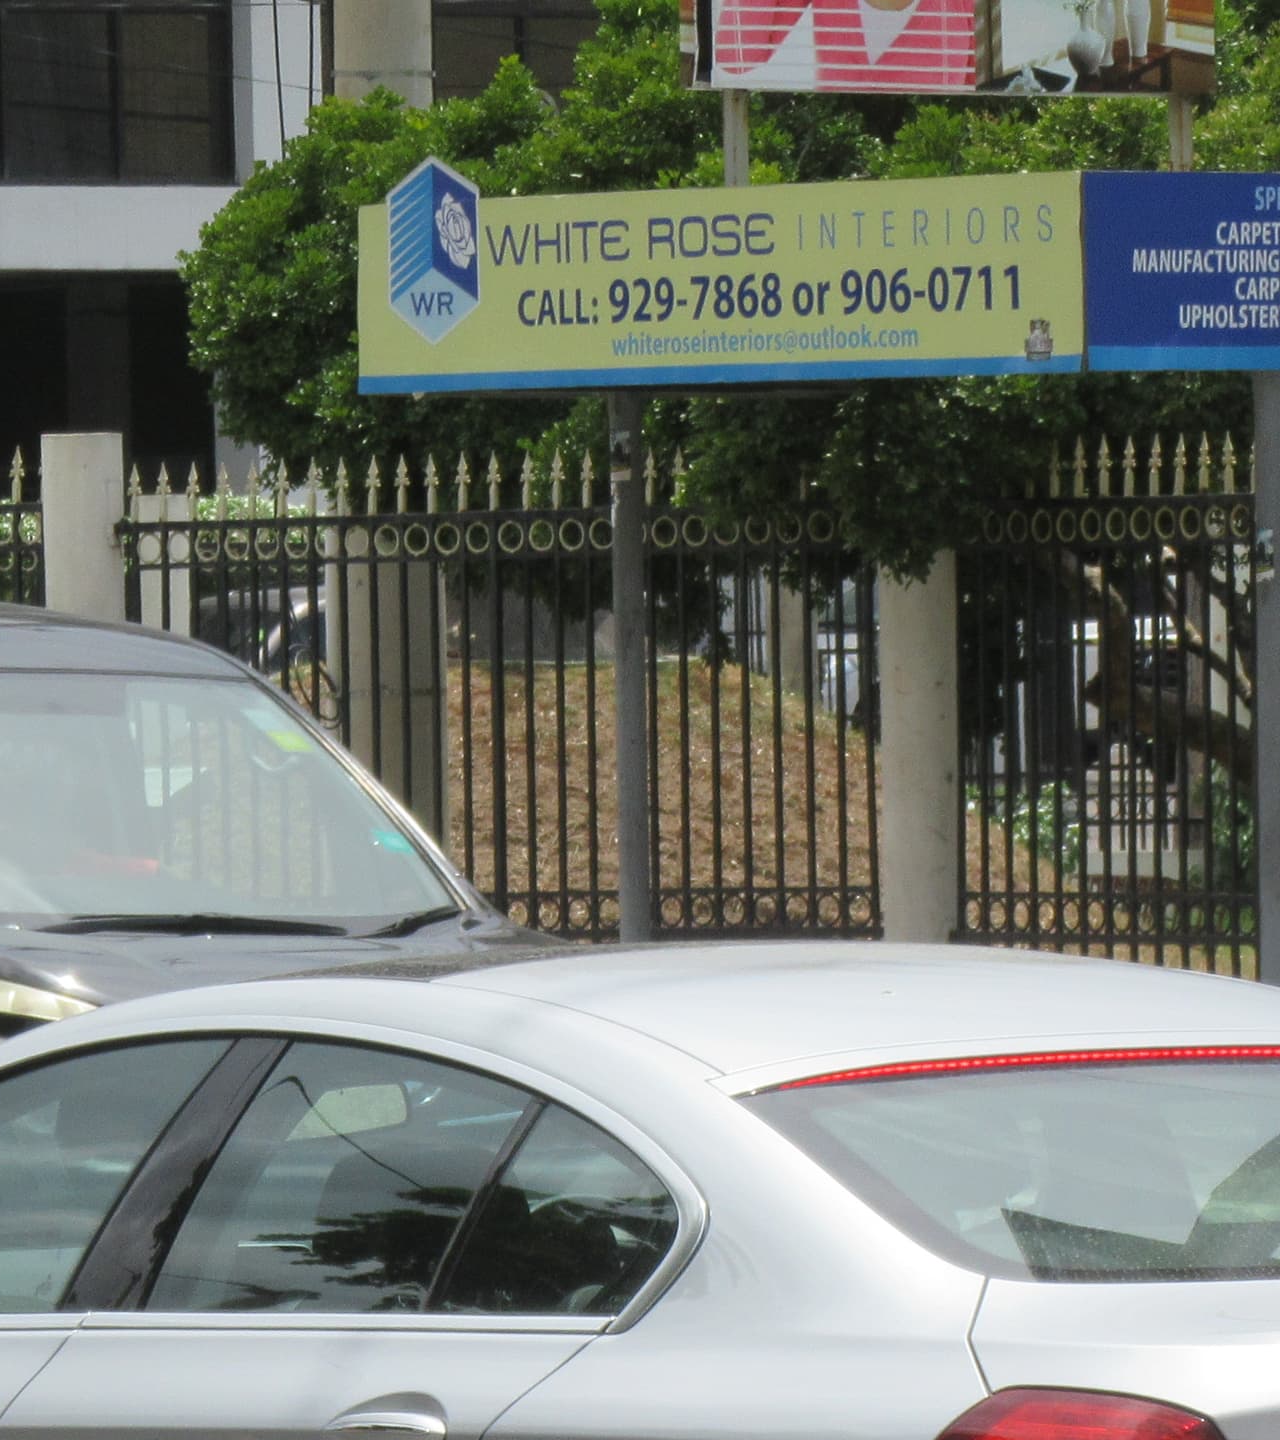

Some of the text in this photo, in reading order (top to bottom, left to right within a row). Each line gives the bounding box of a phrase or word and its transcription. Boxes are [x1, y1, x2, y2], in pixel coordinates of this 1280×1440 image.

[485, 203, 1054, 266] WHITE ROSE INTERIORS
[1132, 248, 1280, 274] MANUFACTURING
[411, 290, 454, 318] WR
[517, 264, 1021, 327] CALL: 929-7868 or 906-0711
[611, 324, 919, 357] whiteroseinteriors@outlook.com
